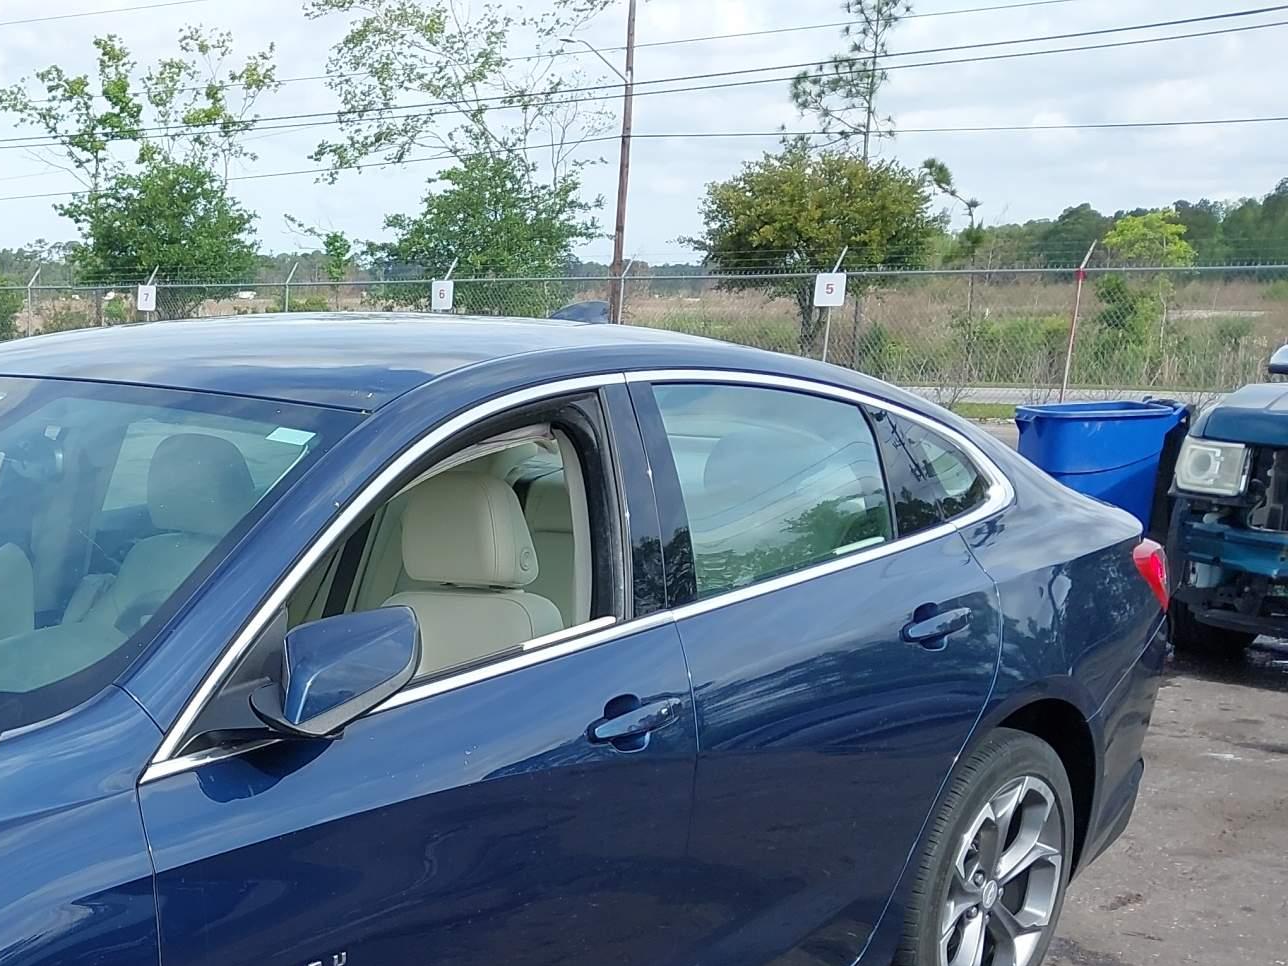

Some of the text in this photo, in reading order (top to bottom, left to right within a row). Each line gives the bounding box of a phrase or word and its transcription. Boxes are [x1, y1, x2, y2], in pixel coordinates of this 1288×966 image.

[438, 289, 446, 299] 6
[825, 283, 834, 295] 5
[143, 292, 150, 302] 7
